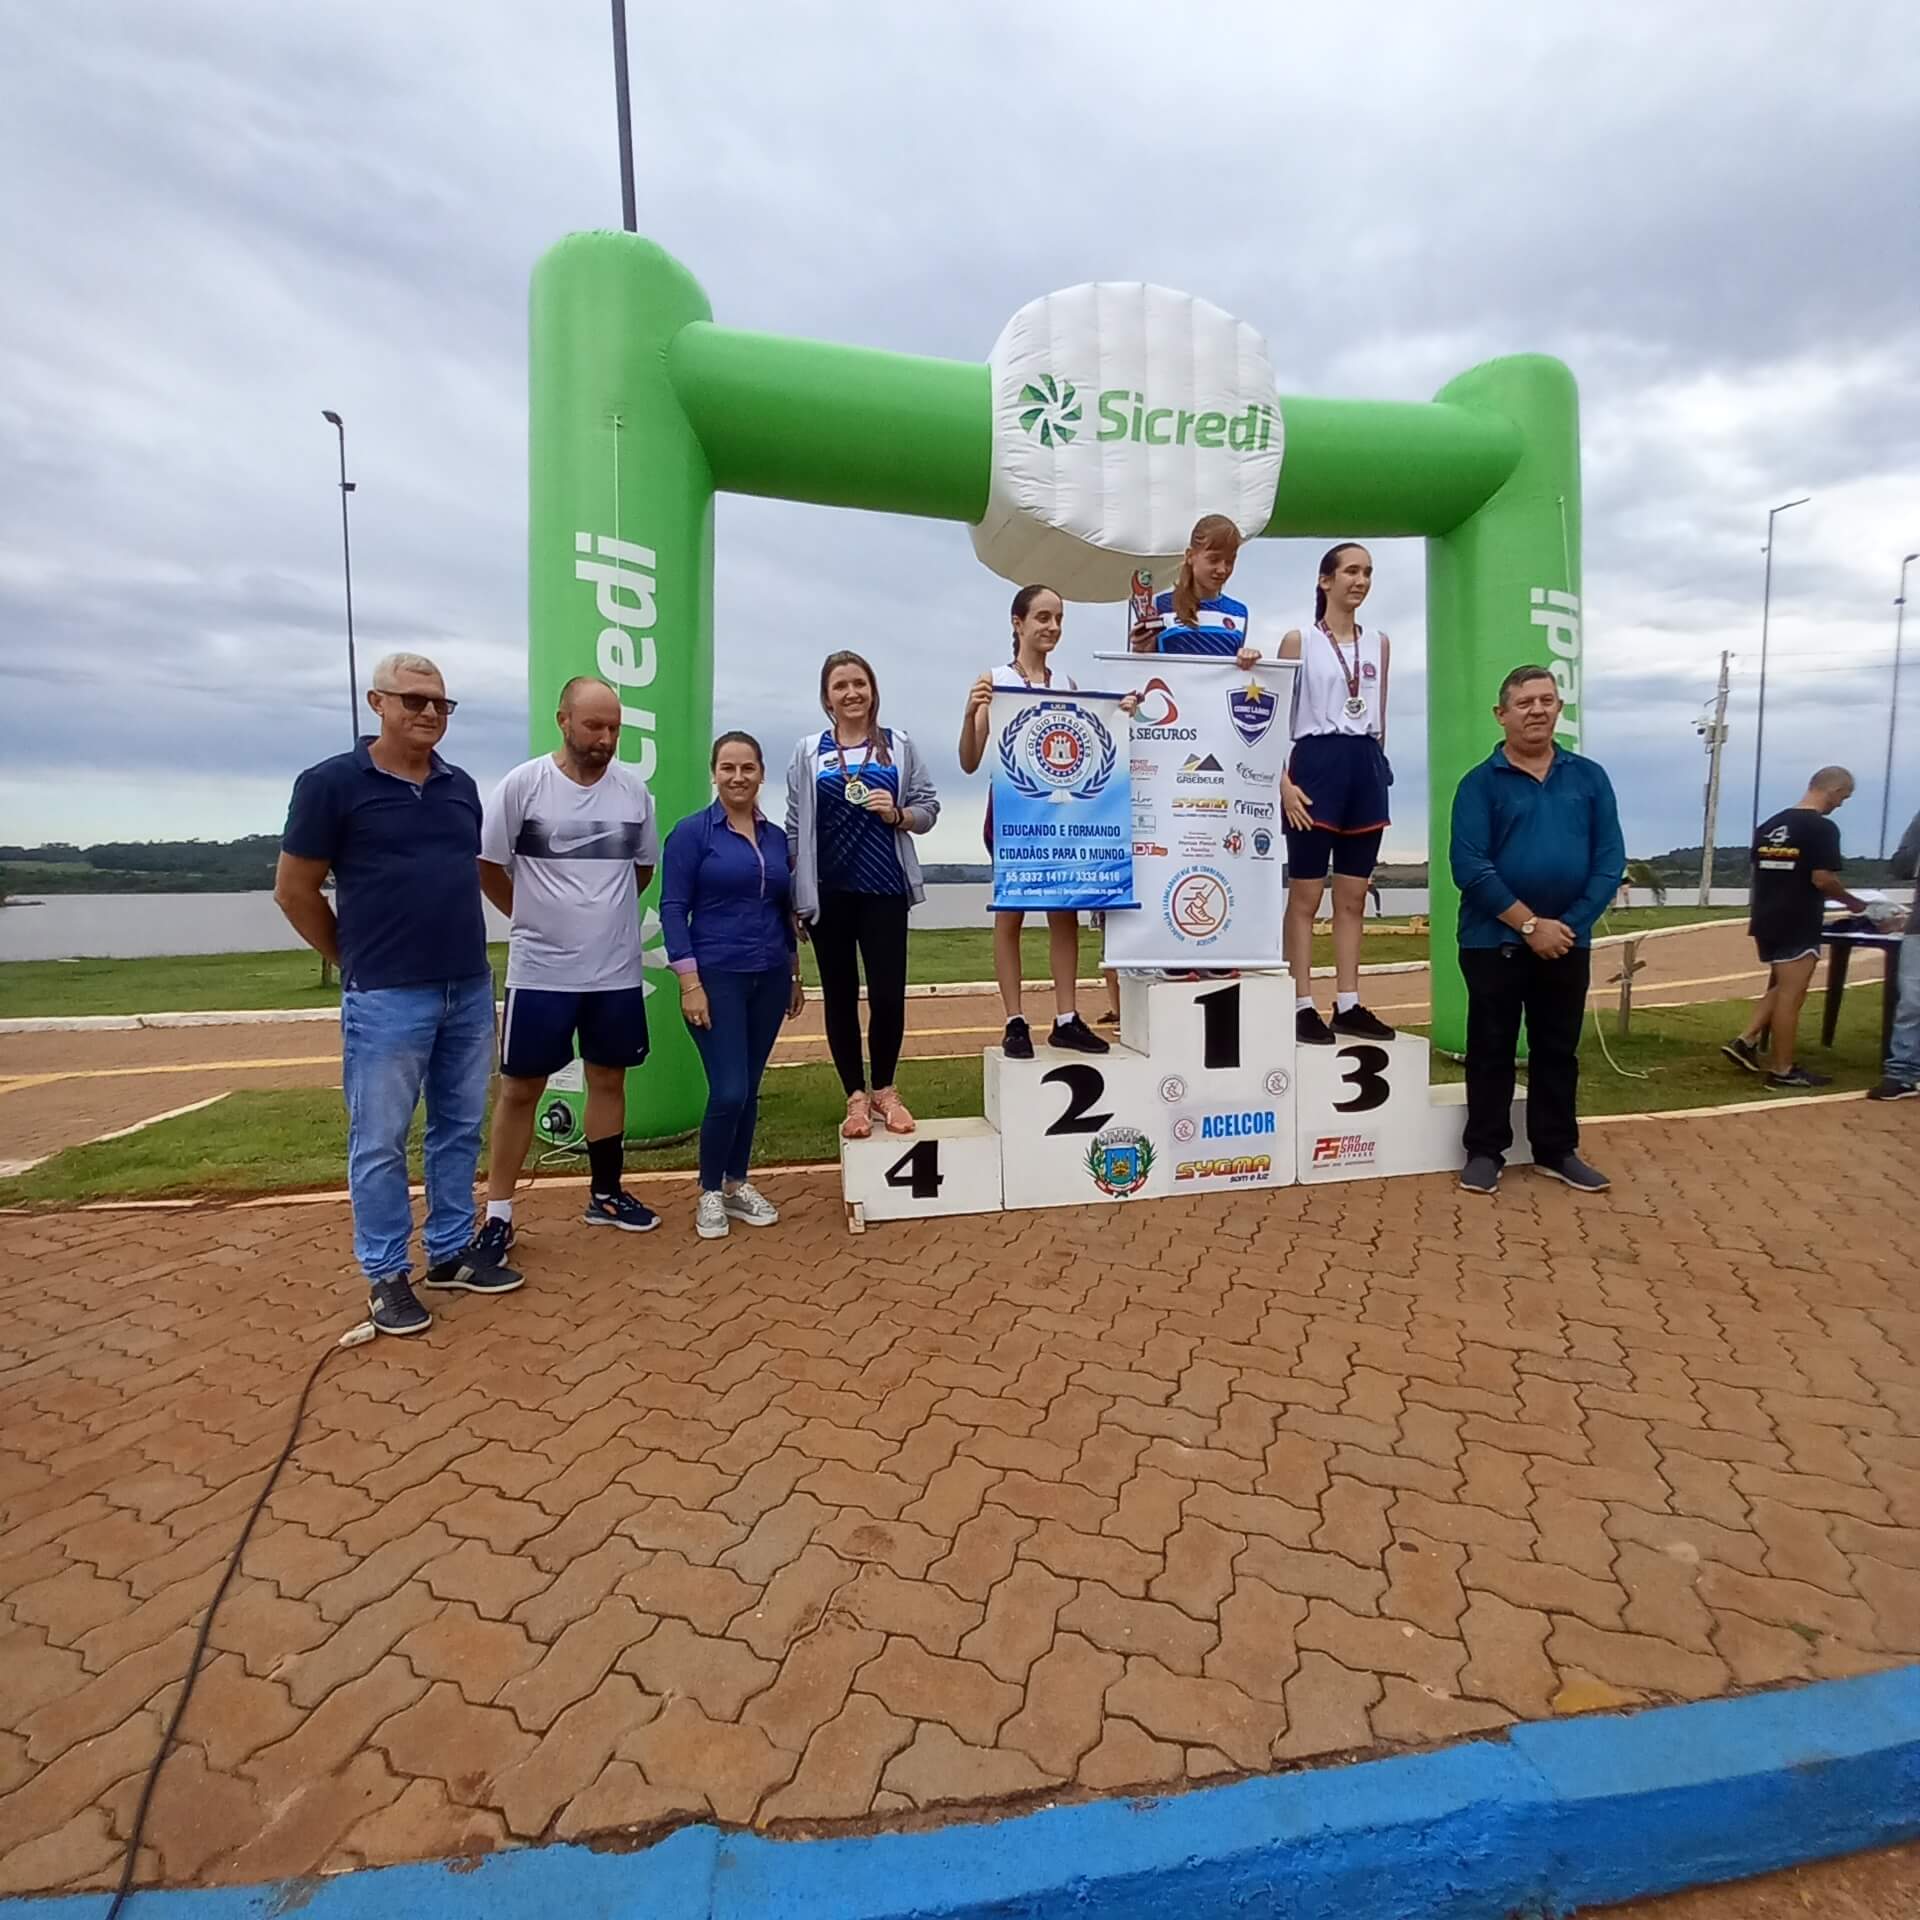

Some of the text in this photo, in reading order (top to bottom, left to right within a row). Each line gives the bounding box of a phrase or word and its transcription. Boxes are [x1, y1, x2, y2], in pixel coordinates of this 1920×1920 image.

[1096, 389, 1272, 453] Sicredi
[1136, 727, 1197, 741] SEGUROS
[1002, 824, 1056, 836] EDUCANDO
[1060, 825, 1065, 836] E
[1068, 825, 1120, 837] FORMANDO
[1000, 845, 1125, 860] CIDADÃOS PARA O MUNDO
[1006, 871, 1017, 881] 55
[1046, 871, 1066, 881] 1417
[1194, 983, 1240, 1068] 1
[1334, 1045, 1390, 1112] 3
[1041, 1064, 1114, 1136] 2
[1202, 1111, 1275, 1138] ACELCOR
[885, 1141, 944, 1198] 4
[1175, 1154, 1271, 1180] SYGMA
